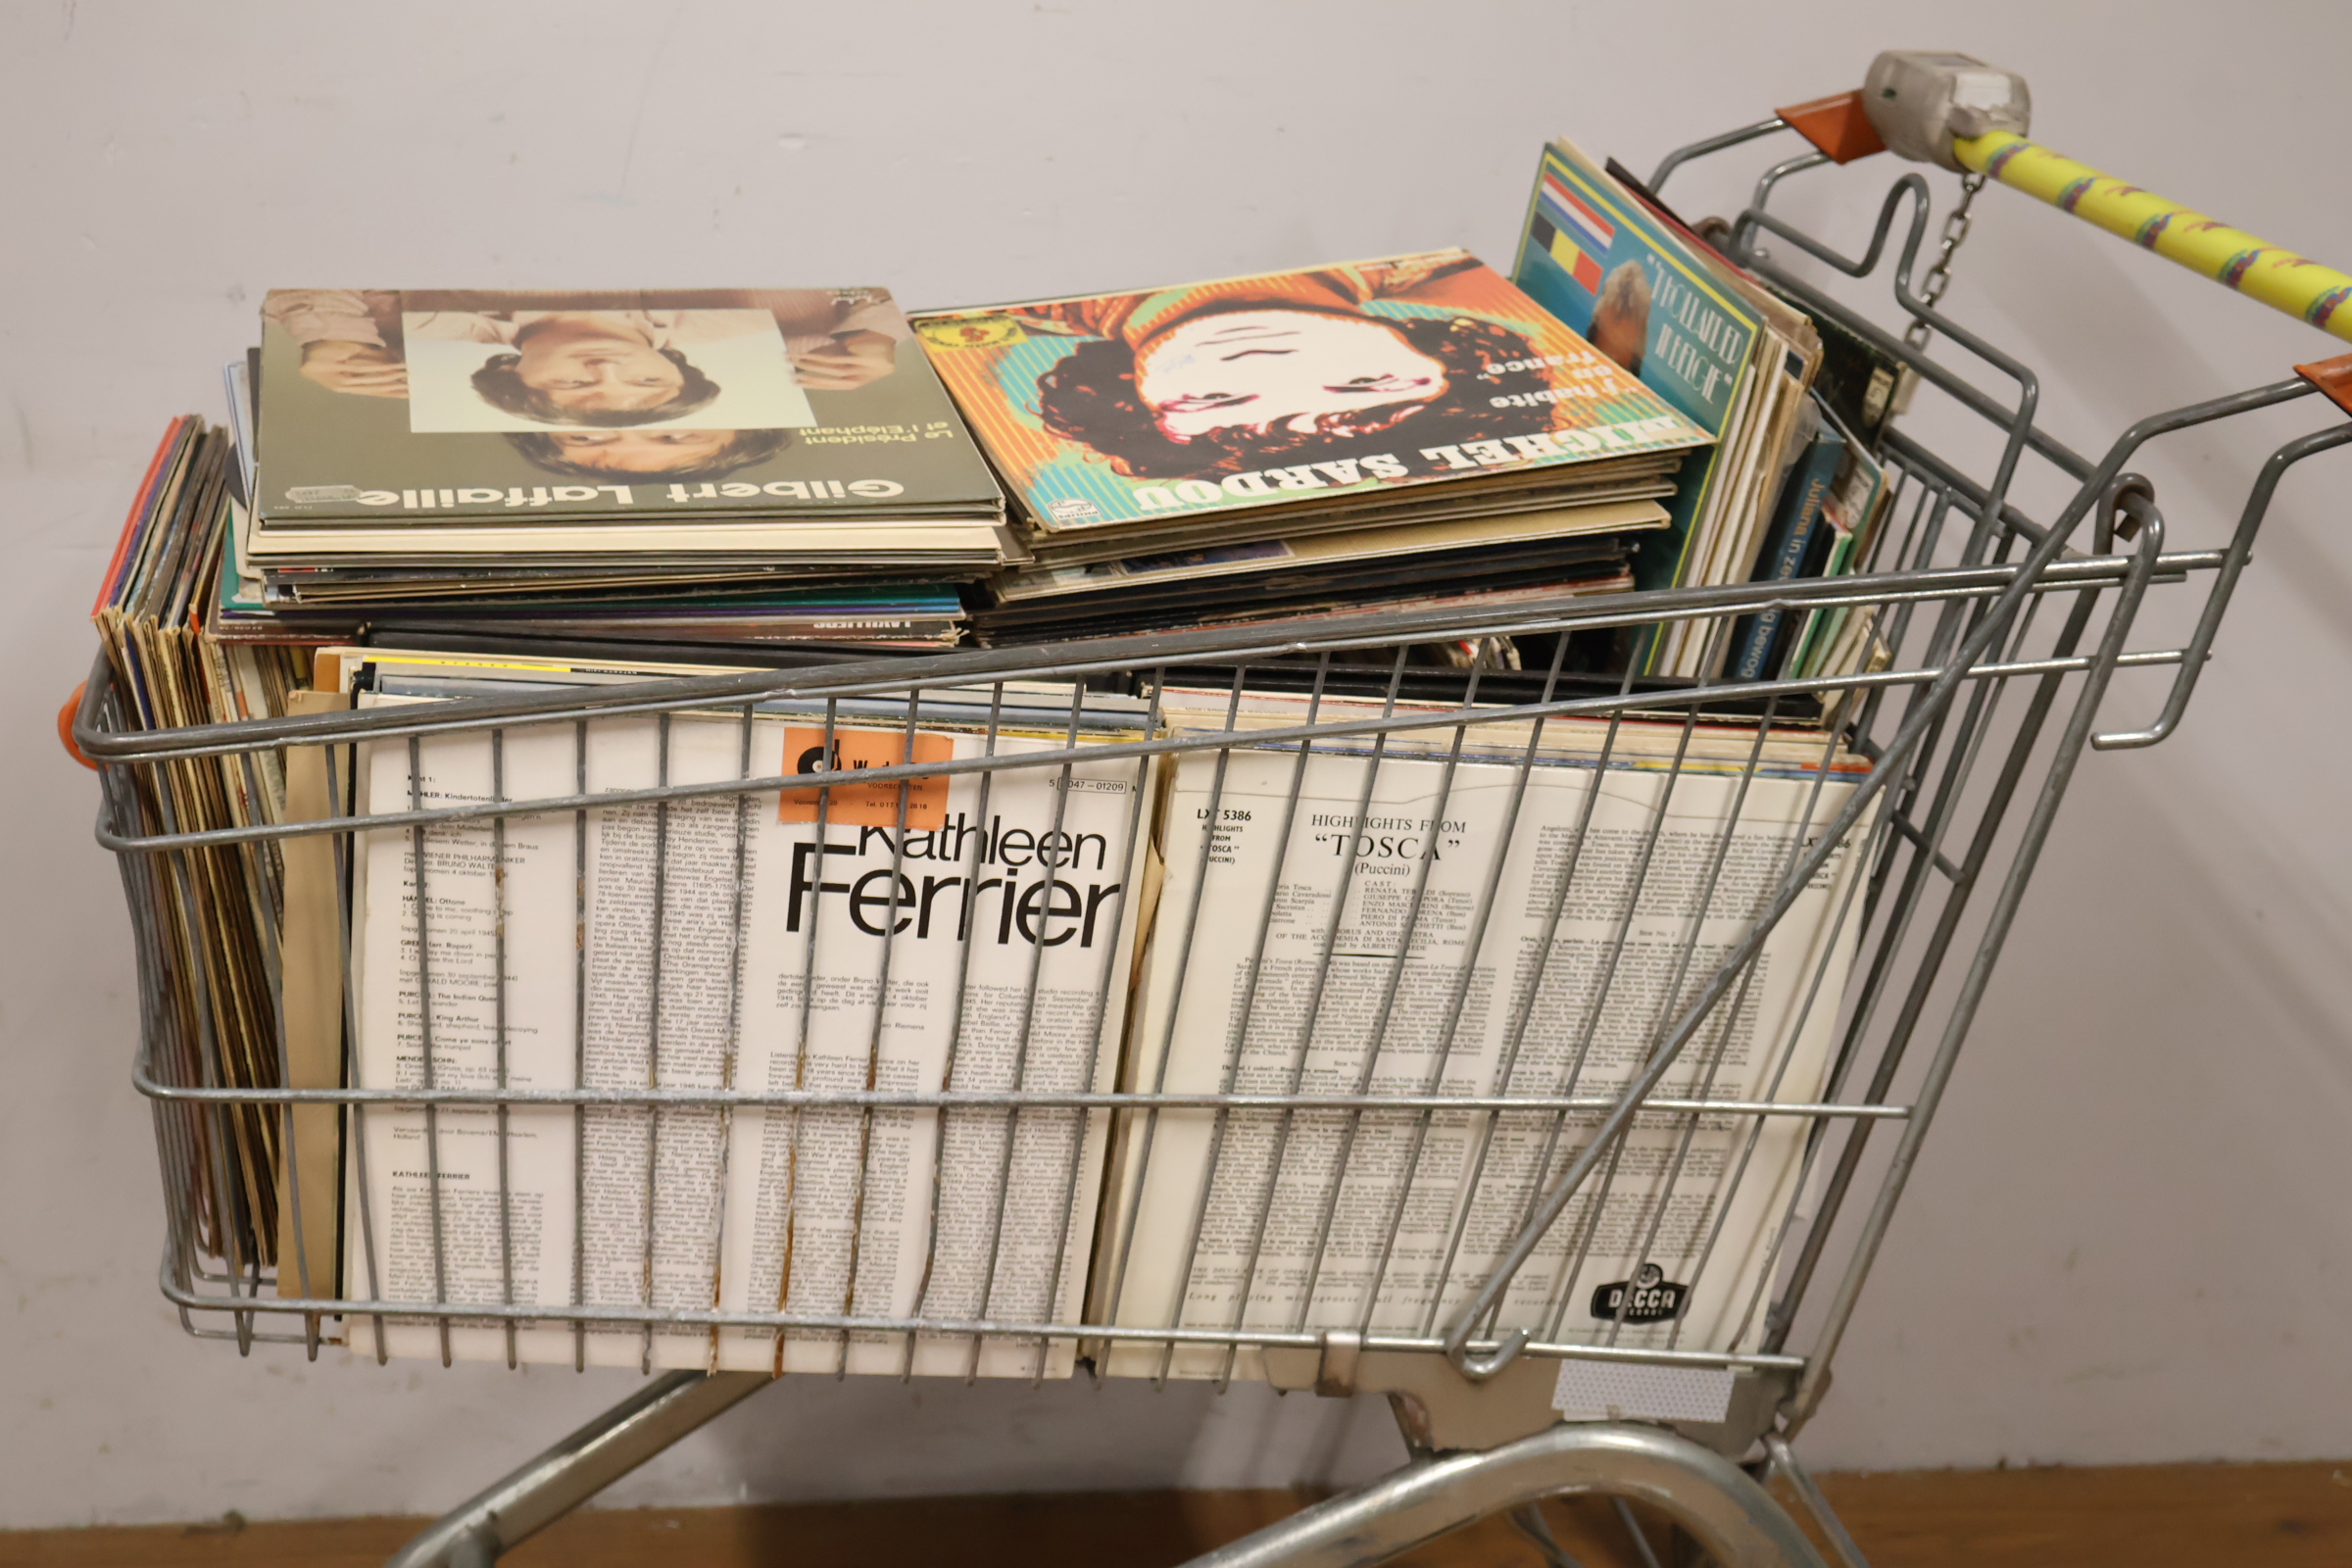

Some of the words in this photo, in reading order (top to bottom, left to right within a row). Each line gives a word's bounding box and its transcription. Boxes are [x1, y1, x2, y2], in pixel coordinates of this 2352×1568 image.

[926, 421, 949, 430] et
[805, 433, 917, 445] Président
[924, 429, 954, 439] Le
[1133, 453, 1409, 512] SARDOU
[353, 484, 634, 509] Laffaille
[666, 478, 905, 505] Gilbert
[1793, 477, 1826, 536] Juliana
[1787, 539, 1807, 555] in
[1096, 782, 1124, 792] 01209
[1223, 809, 1251, 821] 5386
[617, 825, 641, 834] begon
[601, 838, 626, 848] Tijdens
[858, 812, 1106, 870] Kathleen
[517, 842, 539, 851] Braus
[453, 854, 525, 864] PHILHARMNIKER
[672, 852, 696, 860] begon
[437, 859, 466, 868] BRUNO
[599, 861, 643, 870] onopvallend
[1354, 862, 1410, 877] (Puccini)
[599, 868, 627, 877] liederen
[704, 875, 733, 884] Engelse
[786, 842, 1121, 948] Ferrier
[1361, 906, 1407, 915] FERNANDO
[1360, 912, 1385, 921] PIERO
[1360, 942, 1398, 951] ALBERTO
[453, 993, 476, 1002] Indian
[436, 1014, 454, 1023] King
[812, 1054, 844, 1062] Kathleen
[1608, 1289, 1676, 1309] DCCA
